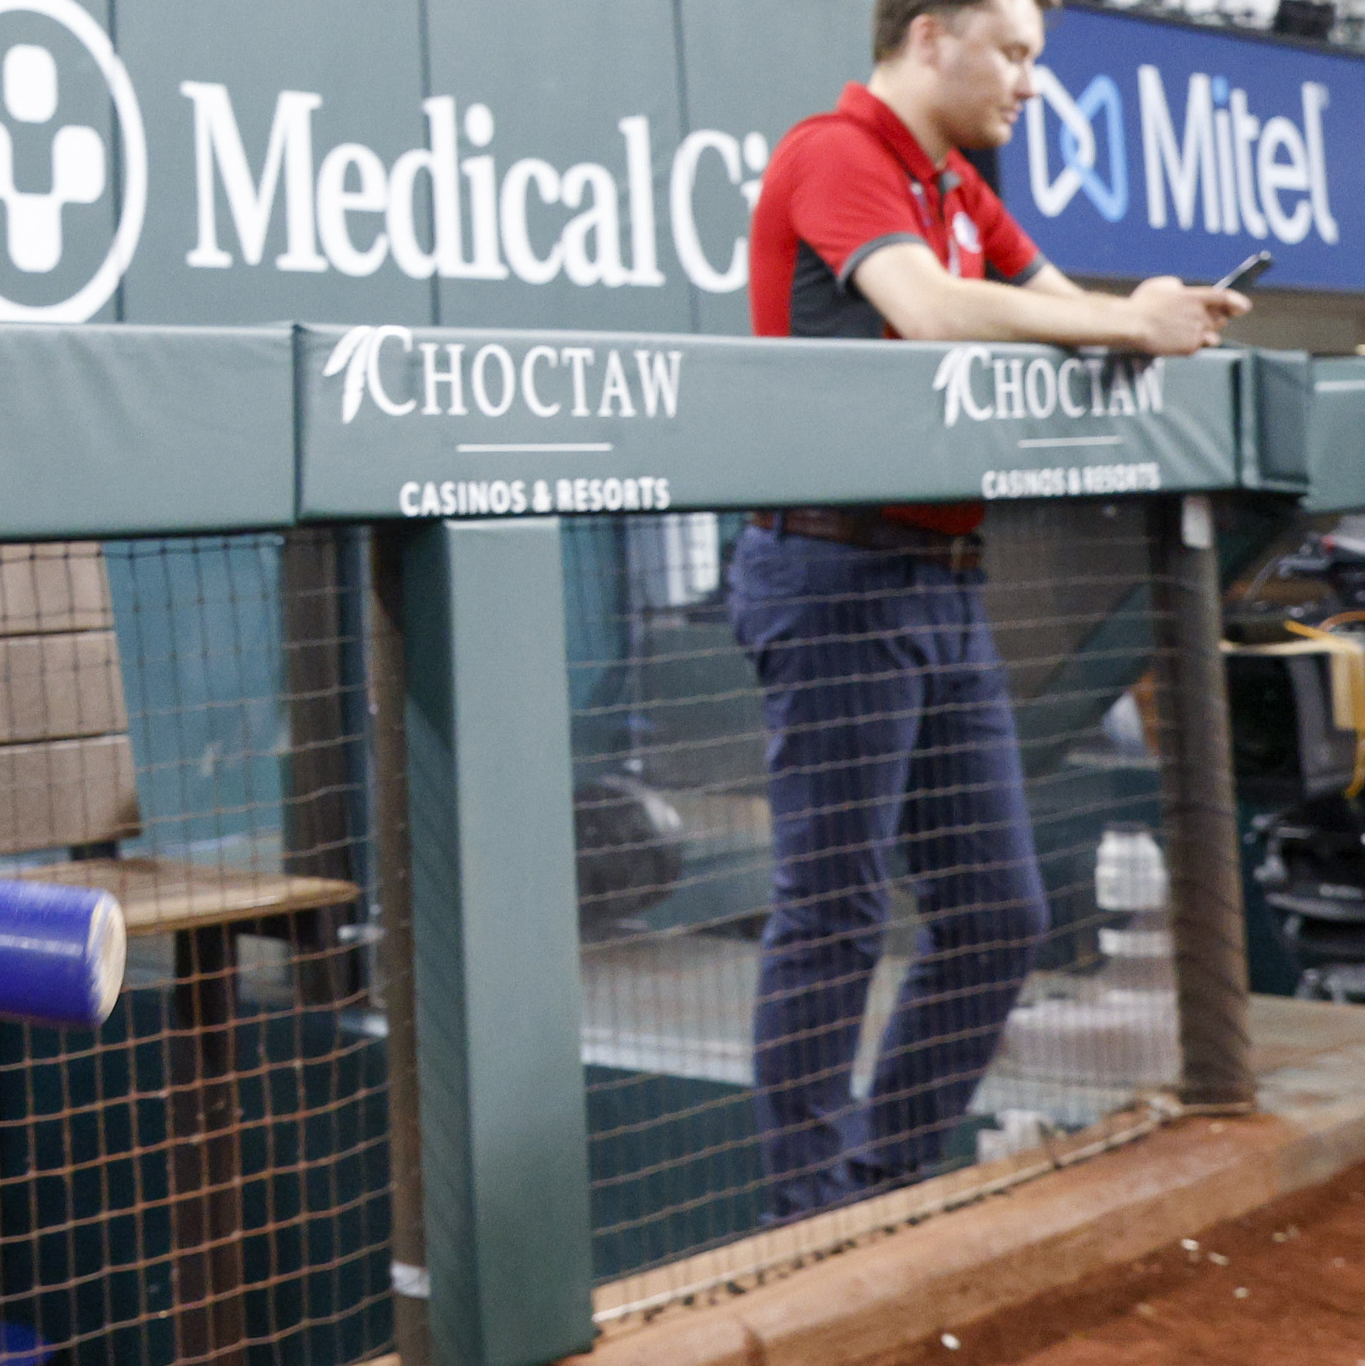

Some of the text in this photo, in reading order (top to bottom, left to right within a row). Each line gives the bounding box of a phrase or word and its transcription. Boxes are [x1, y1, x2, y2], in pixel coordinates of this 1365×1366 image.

[1137, 64, 1339, 245] Mitel
[367, 325, 682, 419] CHOCTAW
[961, 345, 1166, 421] CHOCTAW
[399, 476, 670, 517] CASINOS & RESORTS
